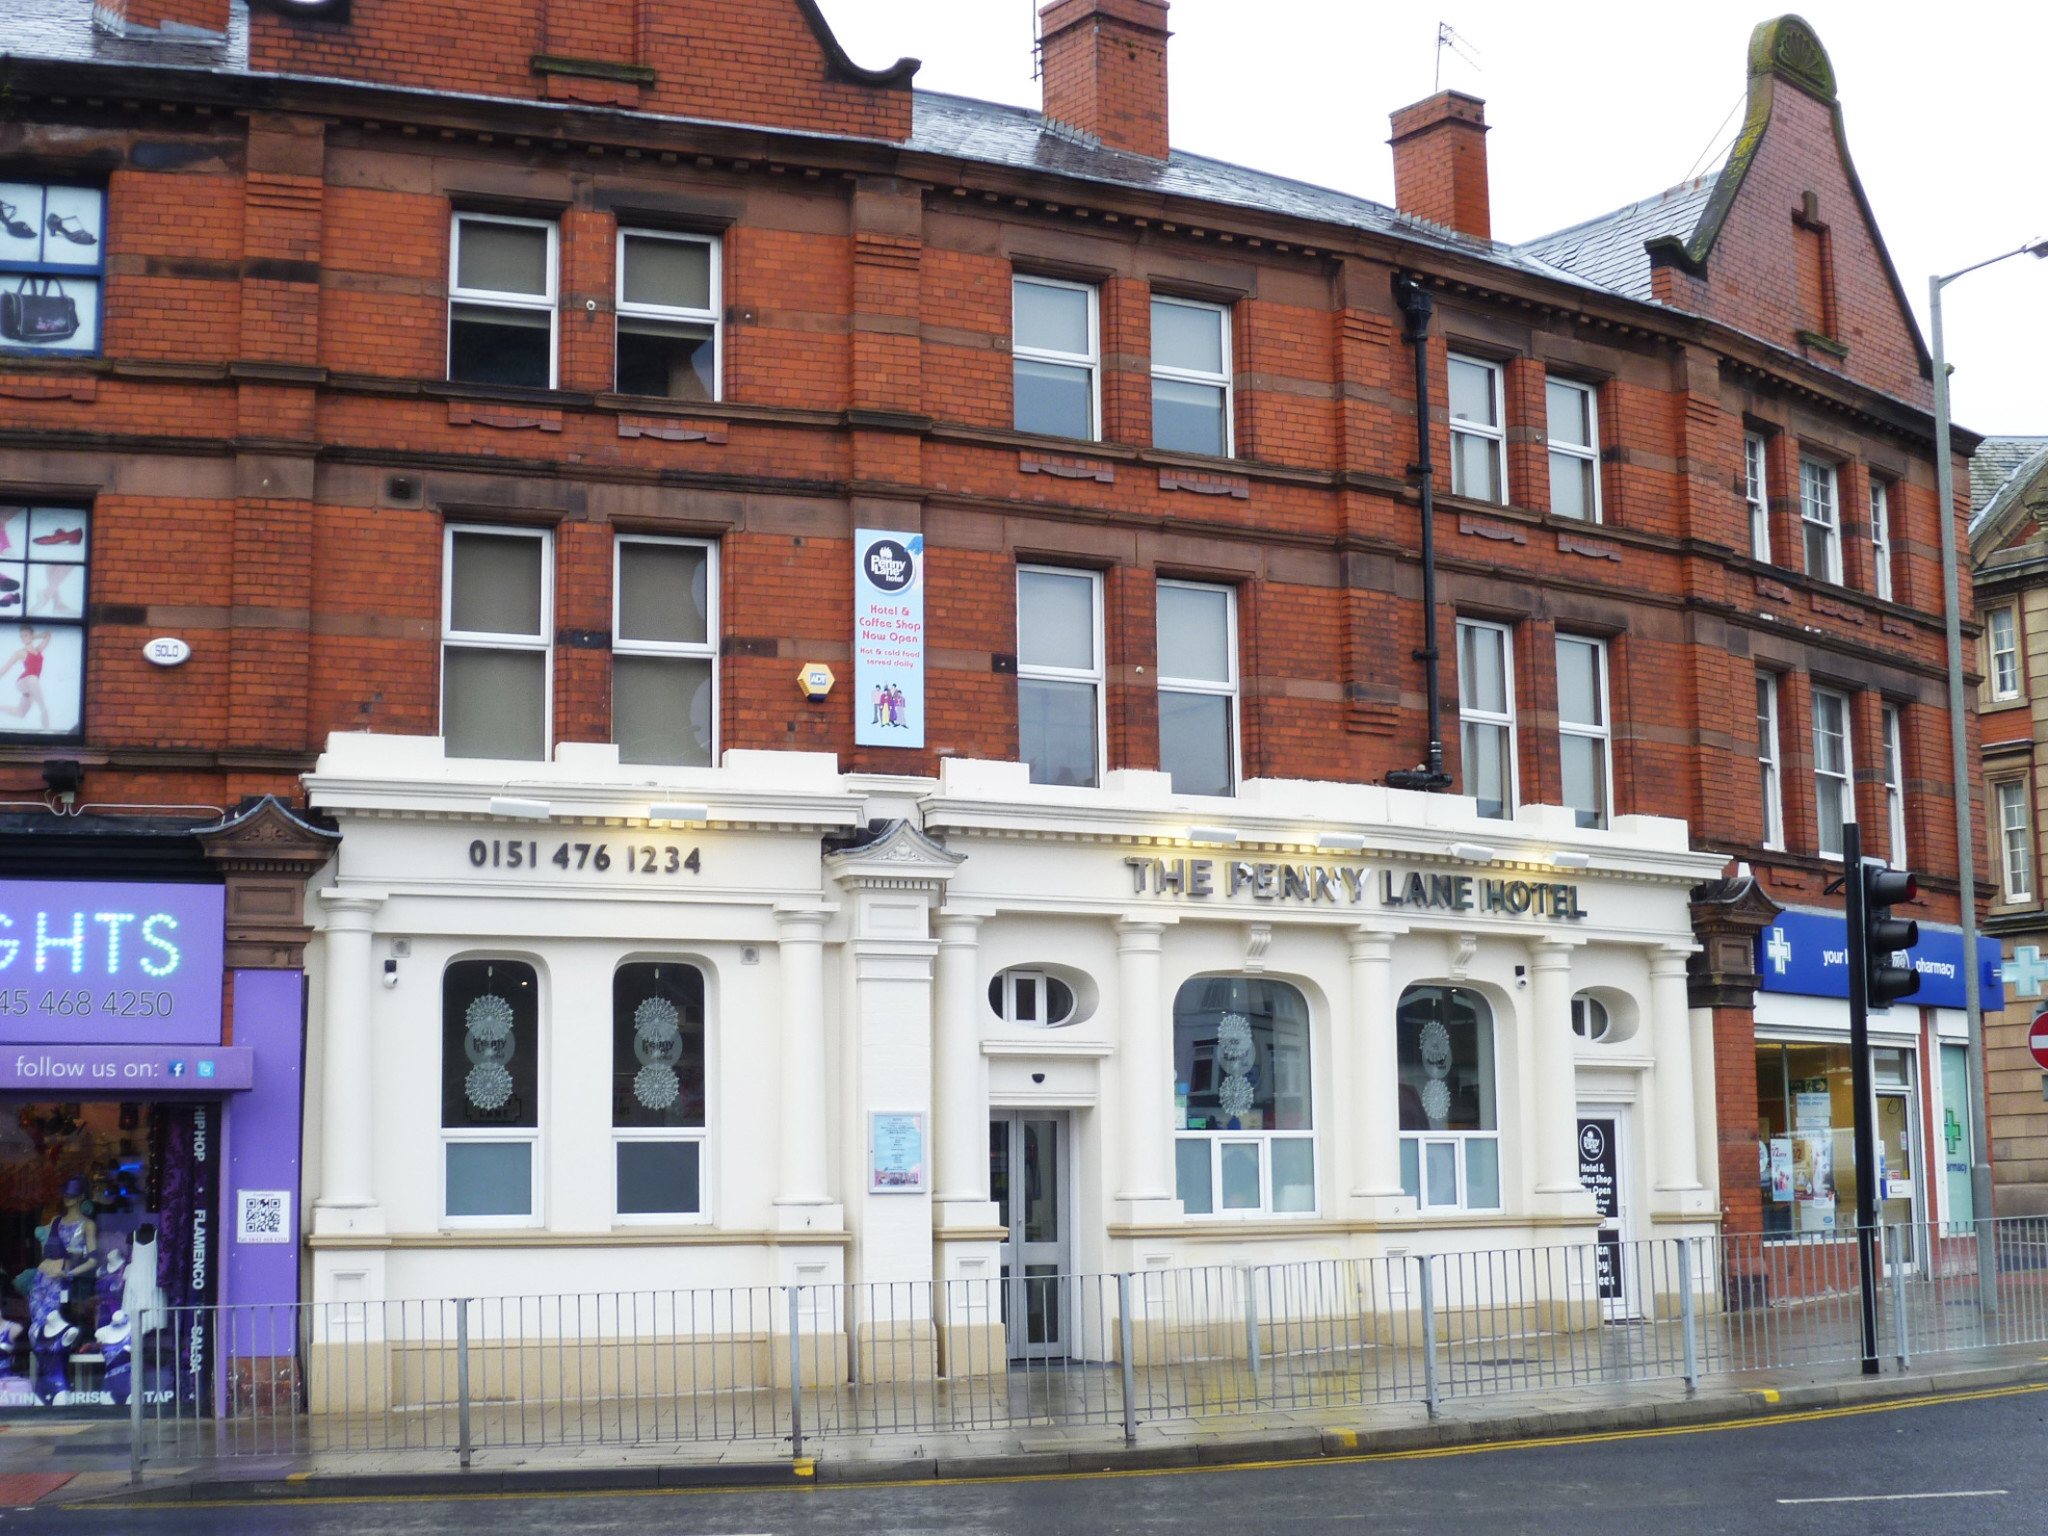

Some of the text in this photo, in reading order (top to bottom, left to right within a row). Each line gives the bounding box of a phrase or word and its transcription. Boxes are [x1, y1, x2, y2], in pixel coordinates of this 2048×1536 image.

[870, 604, 910, 616] Hotel &
[859, 616, 921, 632] Coffee Shop
[862, 630, 918, 644] Now Open
[860, 647, 873, 655] Hot
[902, 650, 920, 658] food
[893, 660, 914, 669] daily
[469, 839, 701, 874] 0151 476 1234
[1124, 856, 1588, 918] THE PENNY LANE HOTEL
[1823, 950, 1844, 966] your
[1915, 957, 1955, 979] pharmacy
[38, 990, 92, 1017] 468
[101, 991, 174, 1018] 4250
[15, 1055, 159, 1078] follow us on:
[193, 1104, 206, 1162] HIP HOP
[1580, 1162, 1605, 1173] Hotel &
[1946, 1163, 1968, 1175] armacy
[1579, 1174, 1613, 1186] offee Shop
[1592, 1186, 1612, 1197] Open
[192, 1209, 207, 1290] FLAMENCO
[190, 1325, 203, 1374] SALSA
[144, 1391, 175, 1403] TAP
